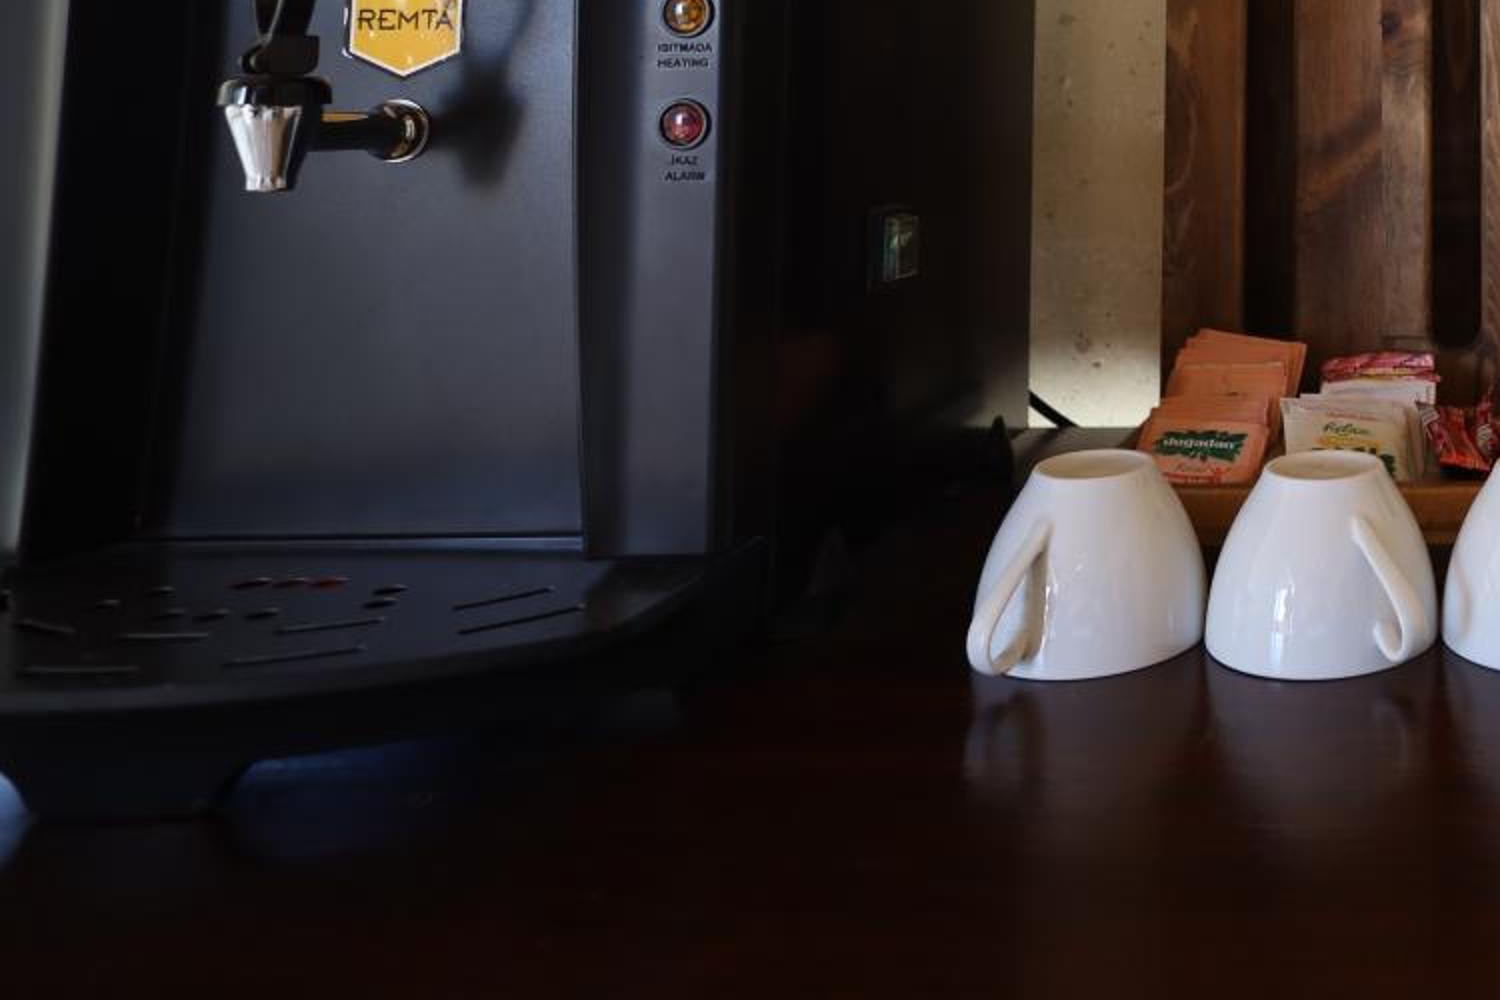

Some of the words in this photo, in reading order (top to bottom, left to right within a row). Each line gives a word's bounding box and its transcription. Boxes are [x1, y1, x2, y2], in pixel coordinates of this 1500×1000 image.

[357, 8, 454, 31] REMTA
[657, 58, 709, 69] HEATING
[664, 171, 705, 181] ALARM
